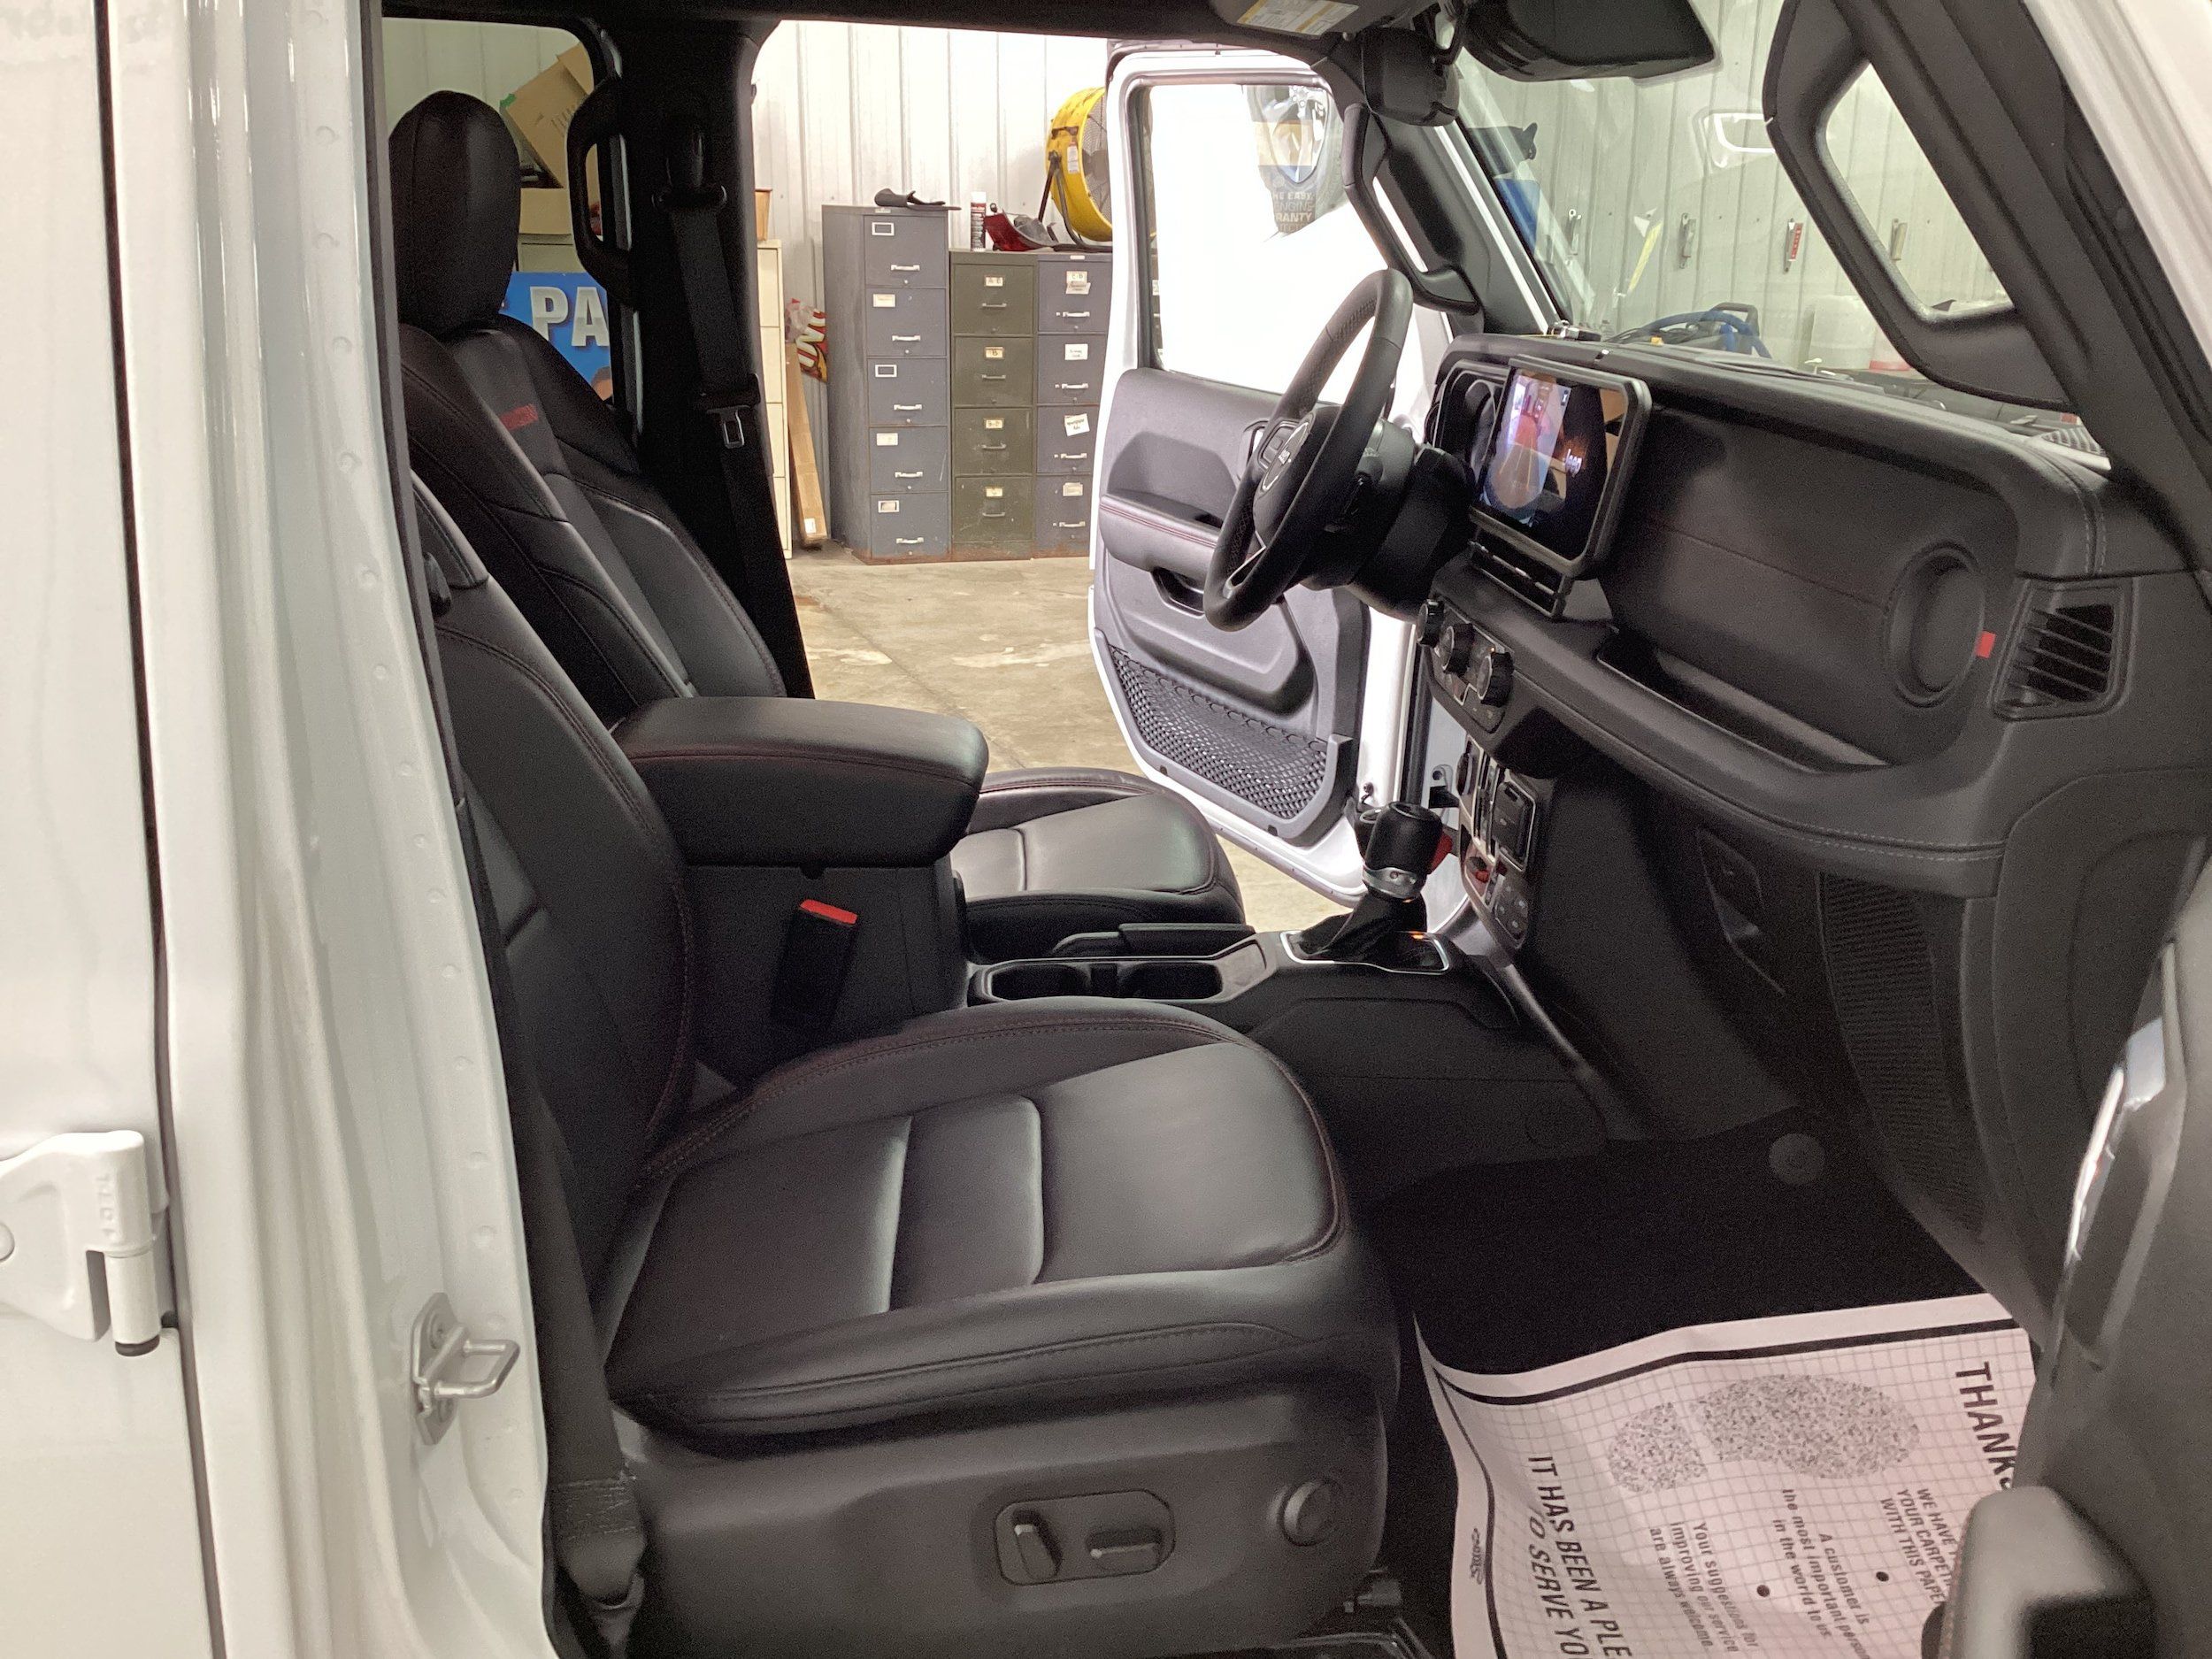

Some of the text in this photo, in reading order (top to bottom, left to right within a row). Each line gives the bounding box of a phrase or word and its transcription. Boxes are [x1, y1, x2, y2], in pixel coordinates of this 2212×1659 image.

[530, 286, 610, 346] PA
[1528, 1456, 1558, 1477] IT
[1537, 1486, 1574, 1532] HAS
[1773, 1519, 1786, 1532] in
[1880, 1498, 1907, 1533] WITH
[1899, 1537, 1924, 1566] THIS
[1897, 1489, 1924, 1526] YOUR
[1917, 1488, 1956, 1545] WE HAVE
[1555, 1540, 1601, 1592] BEEN
[1649, 1528, 1666, 1551] are
[1658, 1556, 1686, 1598] always
[1779, 1537, 1796, 1559] the
[1782, 1489, 1798, 1510] the
[1792, 1516, 1815, 1550] most
[1807, 1555, 1847, 1622] important
[1529, 1544, 1575, 1619] SERVE
[1555, 1627, 1590, 1659] YO
[1671, 1522, 1739, 1652] improving our service
[1694, 1523, 1713, 1555] Your
[1705, 1560, 1748, 1630] suggestions
[1791, 1564, 1817, 1606] world
[1819, 1533, 1870, 1624] A customer is
[1580, 1599, 1609, 1612] A
[1808, 1609, 1822, 1622] to
